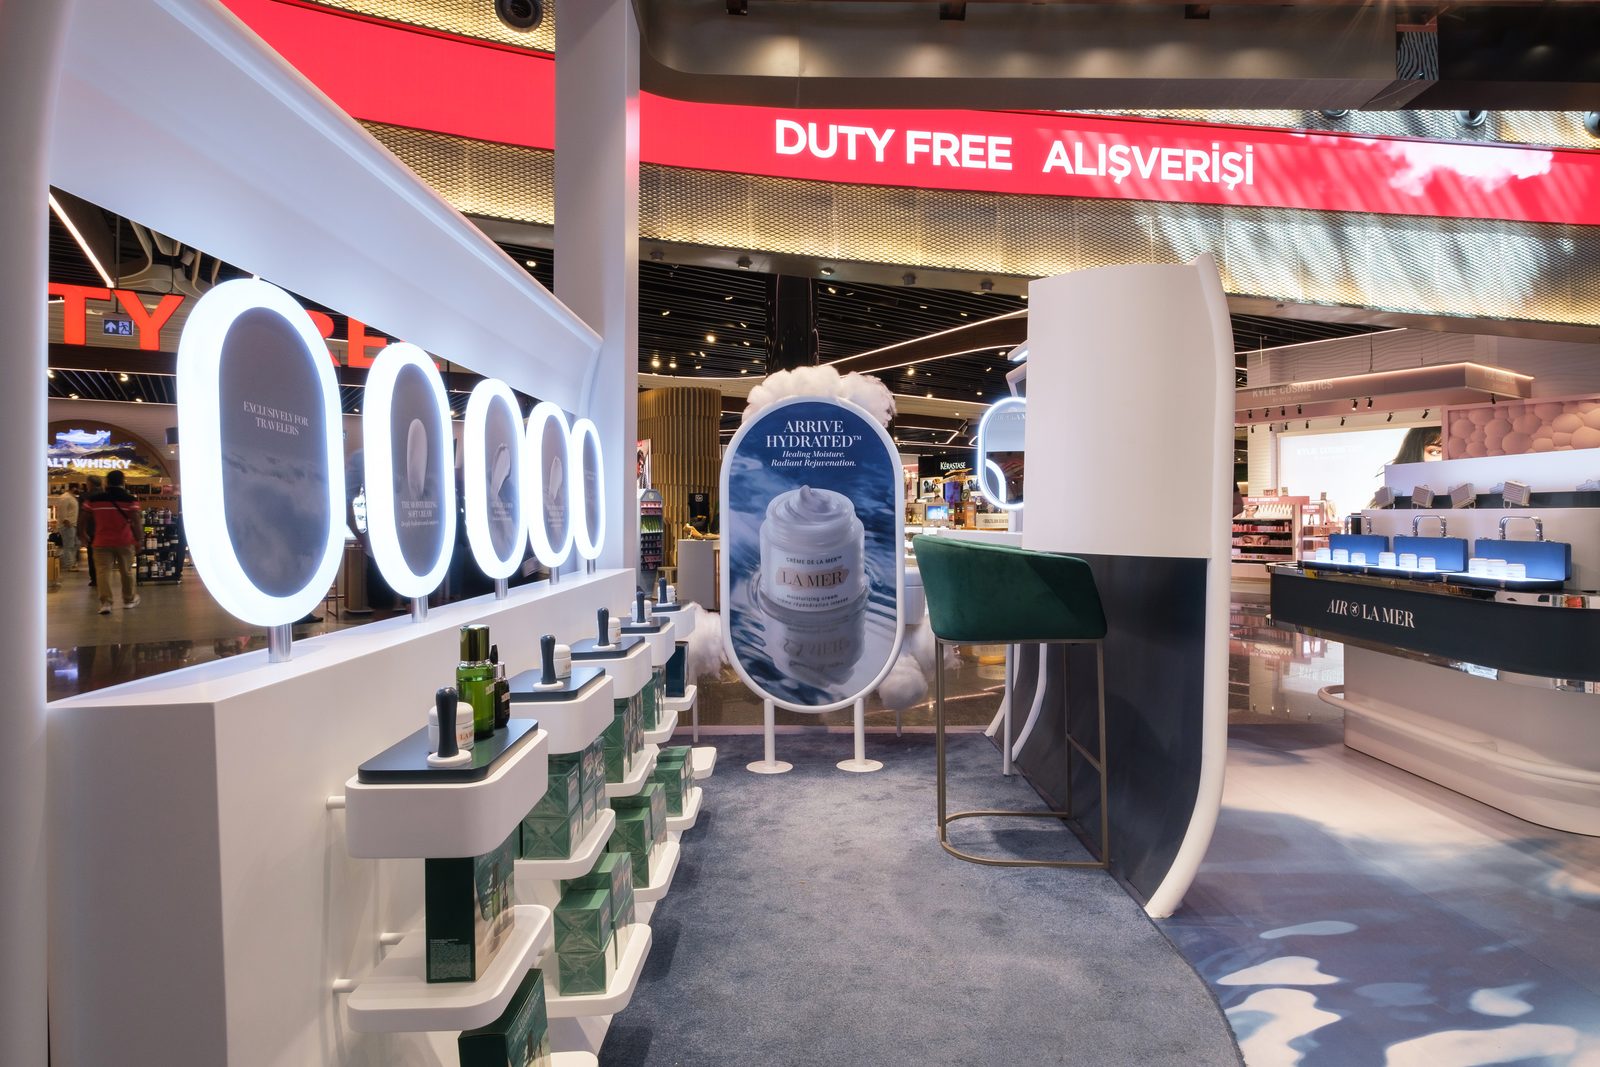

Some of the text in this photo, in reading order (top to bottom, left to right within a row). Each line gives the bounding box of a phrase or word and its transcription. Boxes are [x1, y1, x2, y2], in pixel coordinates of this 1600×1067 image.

[775, 119, 1254, 191] DUTY FREE ALIŞVERİŞİ
[1252, 387, 1277, 399] KYLIE
[1279, 379, 1334, 395] COSMETICS
[243, 400, 310, 427] EXCLUSIVELY FOR
[255, 416, 300, 436] TRAVELERS
[783, 420, 845, 433] ARRIVE
[72, 458, 132, 469] WHISKY
[782, 450, 811, 459] Healing
[771, 459, 857, 469] Radiant Rejuvenation.
[782, 571, 844, 587] LA MER
[1326, 599, 1415, 629] AIR LA MER
